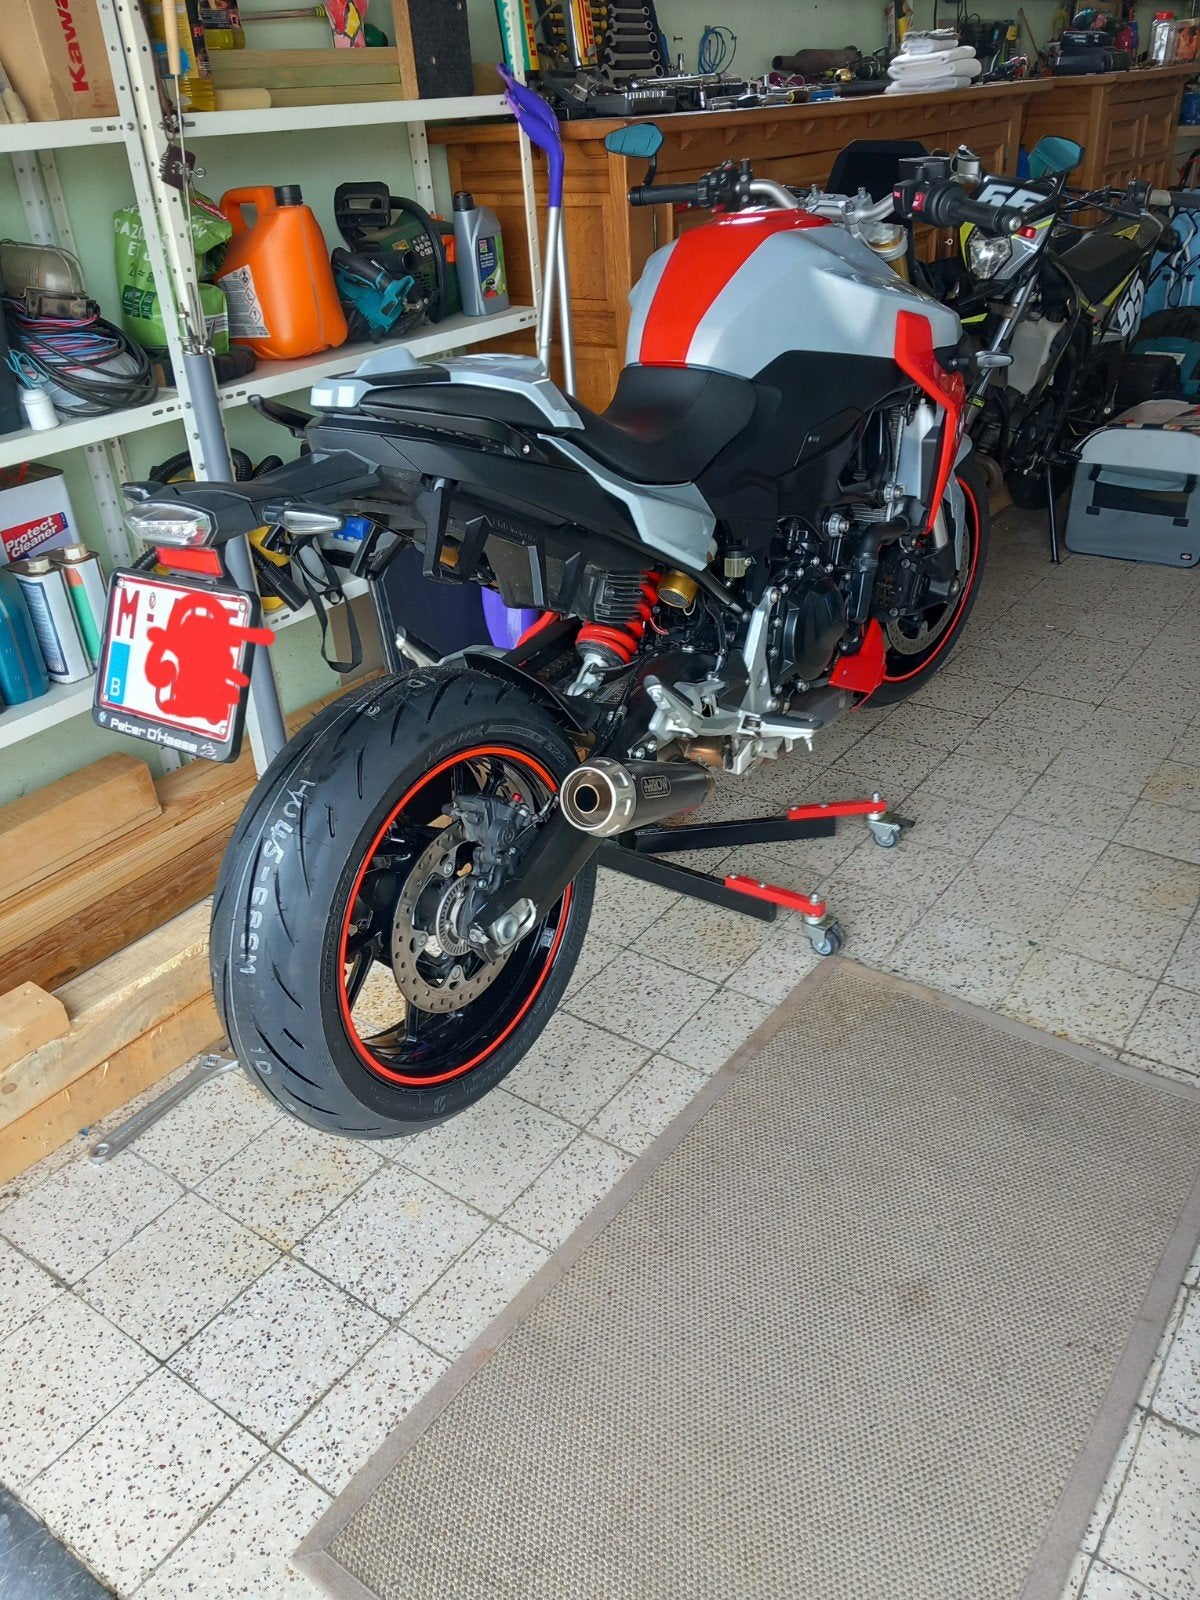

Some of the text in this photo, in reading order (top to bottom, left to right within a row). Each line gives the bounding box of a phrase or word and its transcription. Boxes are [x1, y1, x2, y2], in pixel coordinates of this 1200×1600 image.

[5, 516, 54, 553] Protect
[11, 524, 58, 558] Cleaner
[110, 677, 121, 697] B
[110, 717, 147, 736] Peter
